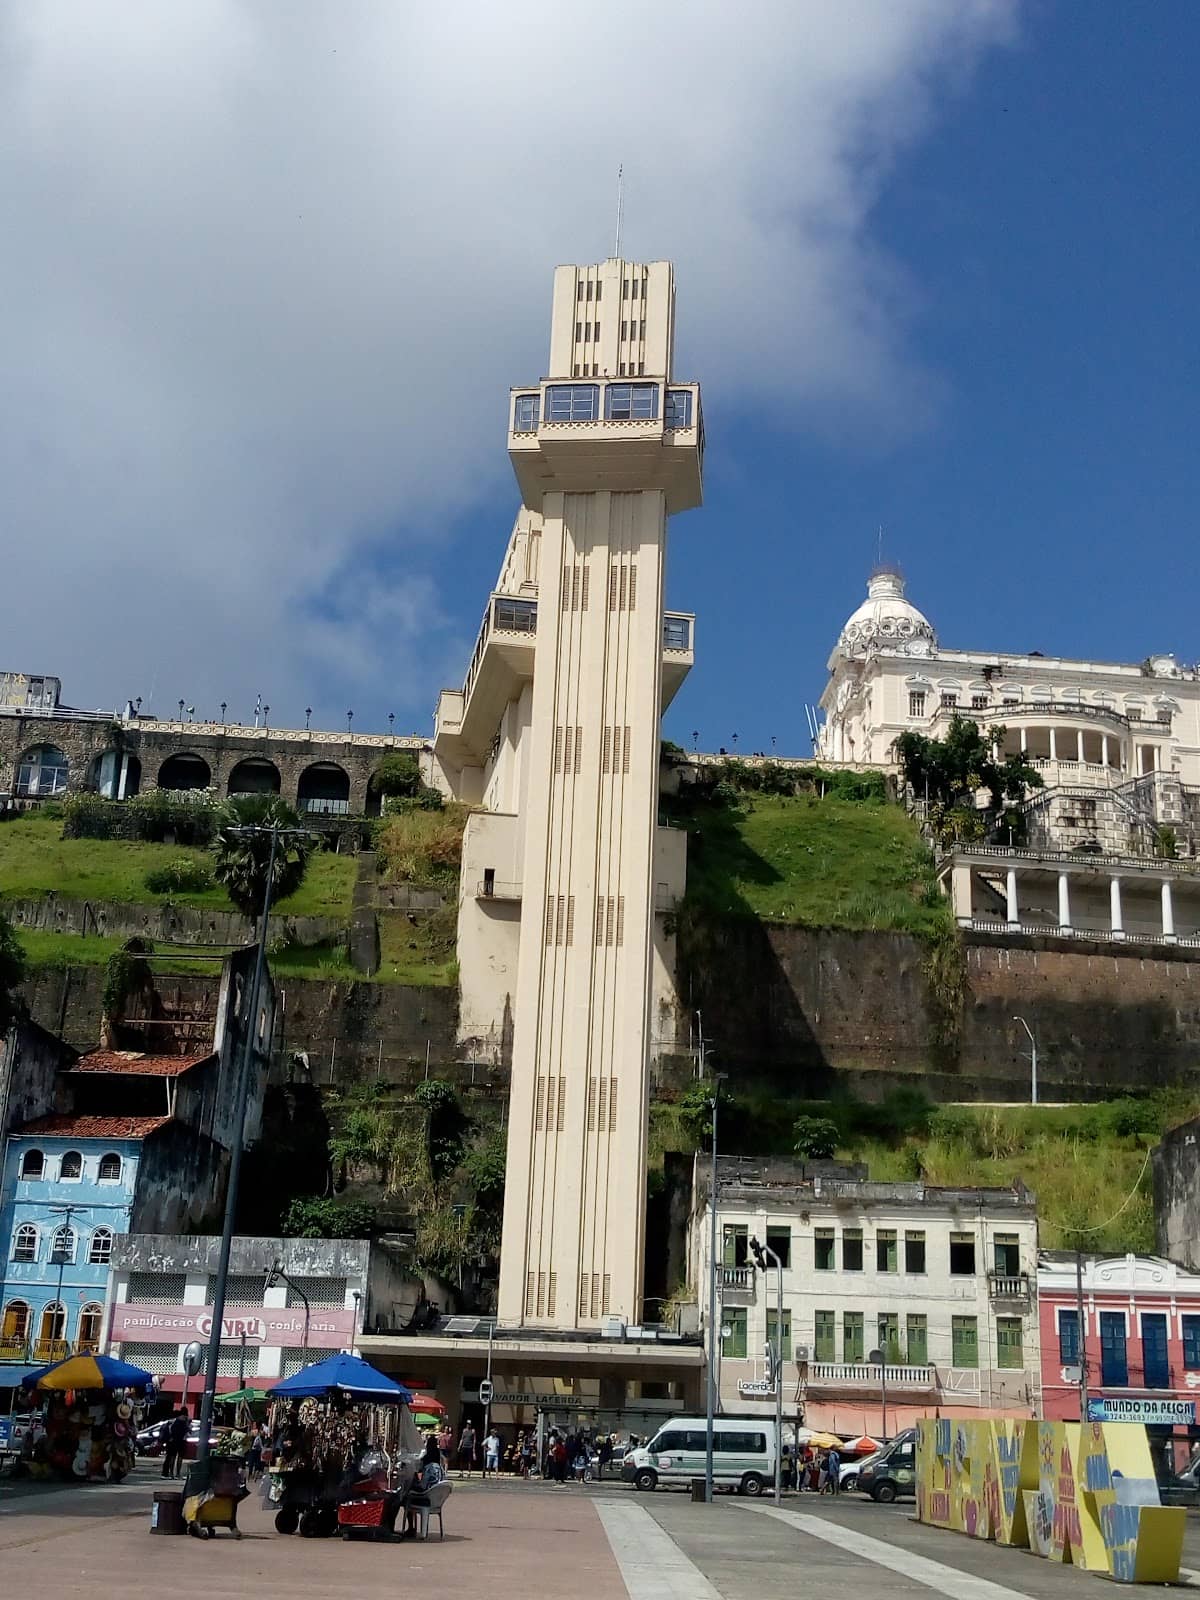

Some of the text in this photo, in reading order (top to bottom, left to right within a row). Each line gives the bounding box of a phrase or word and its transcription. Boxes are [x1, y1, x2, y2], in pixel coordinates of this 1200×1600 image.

[201, 1316, 260, 1337] CYRÚ
[269, 1318, 336, 1331] confearia
[1103, 1399, 1191, 1414] MUNDO DA PESCA
